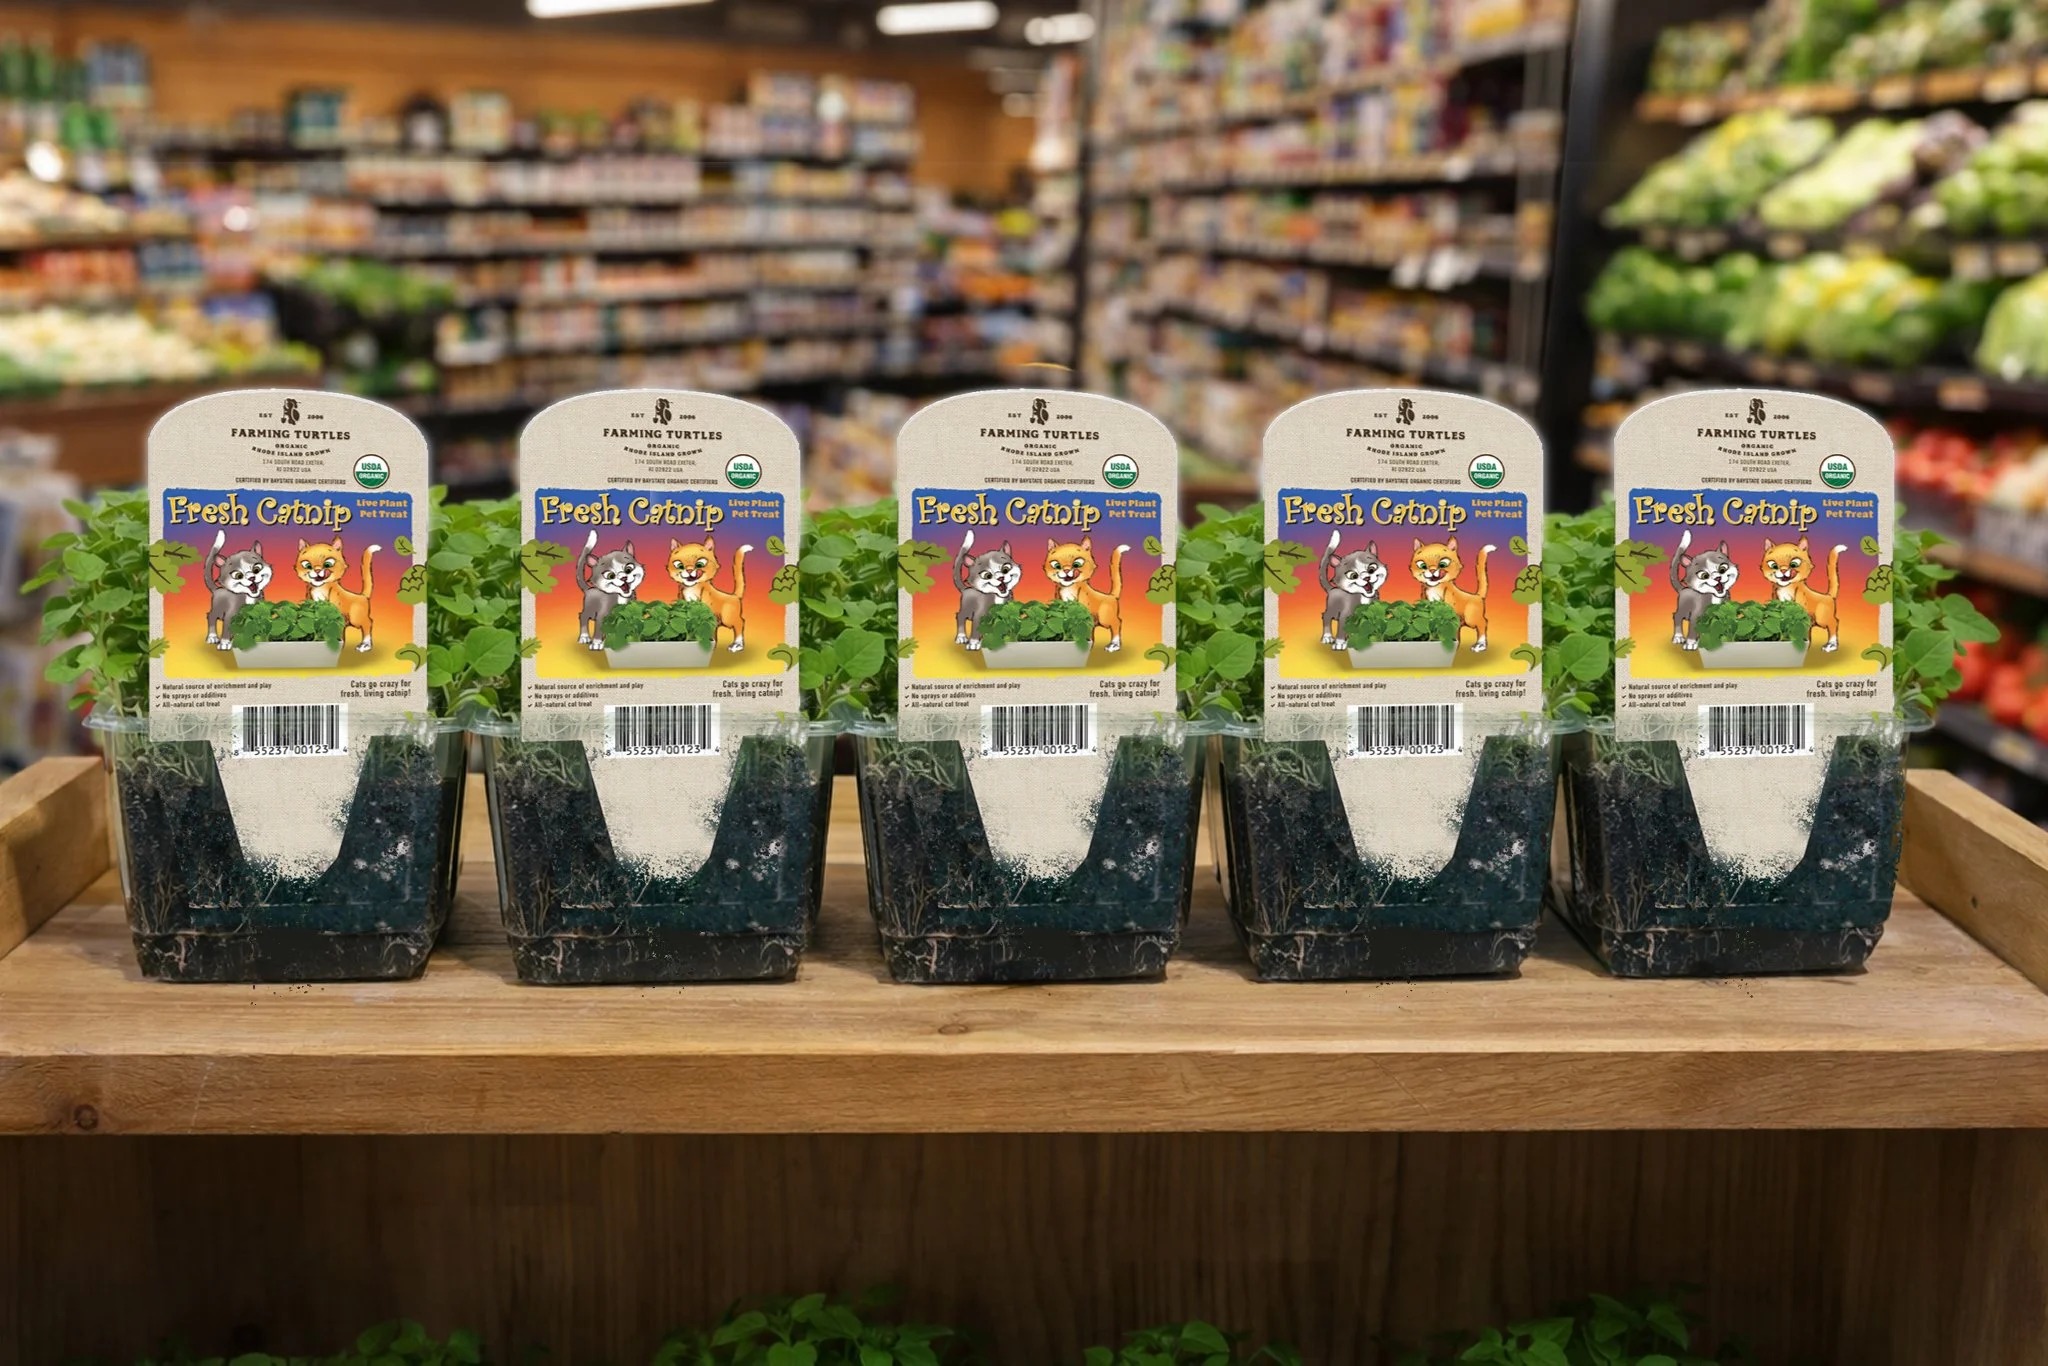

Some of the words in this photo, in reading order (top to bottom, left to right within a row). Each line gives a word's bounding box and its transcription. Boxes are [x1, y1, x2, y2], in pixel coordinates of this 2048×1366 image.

[231, 428, 290, 439] FARMING
[294, 430, 351, 440] TURTLES
[603, 428, 662, 439] FARMING
[666, 430, 723, 440] TURTLES
[980, 428, 1039, 439] FARMING
[1043, 430, 1100, 440] TURTLES
[1346, 428, 1405, 439] FARMING
[1409, 430, 1466, 440] TURTLES
[1697, 428, 1756, 439] FARMING
[1760, 430, 1817, 440] TURTLES
[251, 446, 275, 456] RHODE
[305, 448, 331, 457] GROWN
[623, 446, 647, 456] RHODE
[677, 448, 703, 457] GROWN
[1000, 446, 1024, 456] RHODE
[1054, 448, 1080, 457] GROWN
[1366, 446, 1390, 456] RHODE
[1420, 448, 1446, 457] GROWN
[1717, 446, 1741, 456] RHODE
[1771, 448, 1797, 457] GROWN
[361, 462, 382, 471] USDA
[733, 462, 754, 471] USDA
[1110, 462, 1131, 471] USDA
[1476, 462, 1497, 471] USDA
[1827, 462, 1848, 471] USDA
[356, 499, 378, 507] Live
[379, 499, 408, 507] Plant
[728, 499, 750, 507] Live
[751, 499, 780, 507] Plant
[1105, 499, 1127, 507] Live
[1128, 499, 1157, 507] Plant
[1471, 499, 1493, 507] Live
[1494, 499, 1523, 507] Plant
[1822, 499, 1844, 507] Live
[1845, 499, 1874, 507] Plant
[167, 493, 250, 526] Fresh
[256, 497, 352, 532] Catnip
[360, 510, 377, 518] Pet
[379, 510, 408, 518] Treat
[539, 493, 622, 526] Fresh
[628, 497, 724, 532] Catnip
[732, 510, 749, 518] Pet
[751, 510, 780, 518] Treat
[916, 493, 999, 526] Fresh
[1005, 497, 1101, 532] Catnip
[1109, 510, 1126, 518] Pet
[1128, 510, 1157, 518] Treat
[1282, 493, 1365, 526] Fresh
[1371, 497, 1467, 532] Catnip
[1475, 510, 1492, 518] Pet
[1494, 510, 1523, 518] Treat
[1633, 493, 1716, 526] Fresh
[1722, 497, 1818, 532] Catnip
[1826, 510, 1843, 518] Pet
[1845, 510, 1874, 518] Treat
[350, 680, 367, 688] Cats
[368, 681, 377, 689] go
[380, 680, 398, 689] crazy
[400, 679, 412, 687] for
[722, 680, 739, 688] Cats
[740, 681, 749, 689] go
[752, 680, 770, 689] crazy
[772, 679, 784, 687] for
[1099, 680, 1116, 688] Cats
[1117, 681, 1126, 689] go
[1129, 680, 1147, 689] crazy
[1149, 679, 1161, 687] for
[1465, 680, 1482, 688] Cats
[1483, 681, 1492, 689] go
[1495, 680, 1513, 689] crazy
[1515, 679, 1527, 687] for
[1816, 680, 1833, 688] Cats
[1834, 681, 1843, 689] go
[1846, 680, 1864, 689] crazy
[1866, 679, 1878, 687] for
[363, 690, 384, 698] living
[386, 689, 411, 698] catnip!
[735, 690, 756, 698] living
[758, 689, 783, 698] catnip!
[1112, 690, 1133, 698] living
[1135, 689, 1160, 698] catnip!
[1478, 690, 1499, 698] living
[1501, 689, 1526, 698] catnip!
[1829, 690, 1850, 698] living
[1852, 689, 1877, 698] catnip!
[254, 746, 289, 756] 55237
[294, 745, 329, 755] 00123
[626, 746, 661, 756] 55237
[666, 745, 701, 755] 00123
[1003, 746, 1038, 756] 55237
[1043, 745, 1078, 755] 00123
[1369, 746, 1404, 756] 55237
[1409, 745, 1444, 755] 00123
[1720, 746, 1755, 756] 55237
[1760, 745, 1795, 755] 00123
